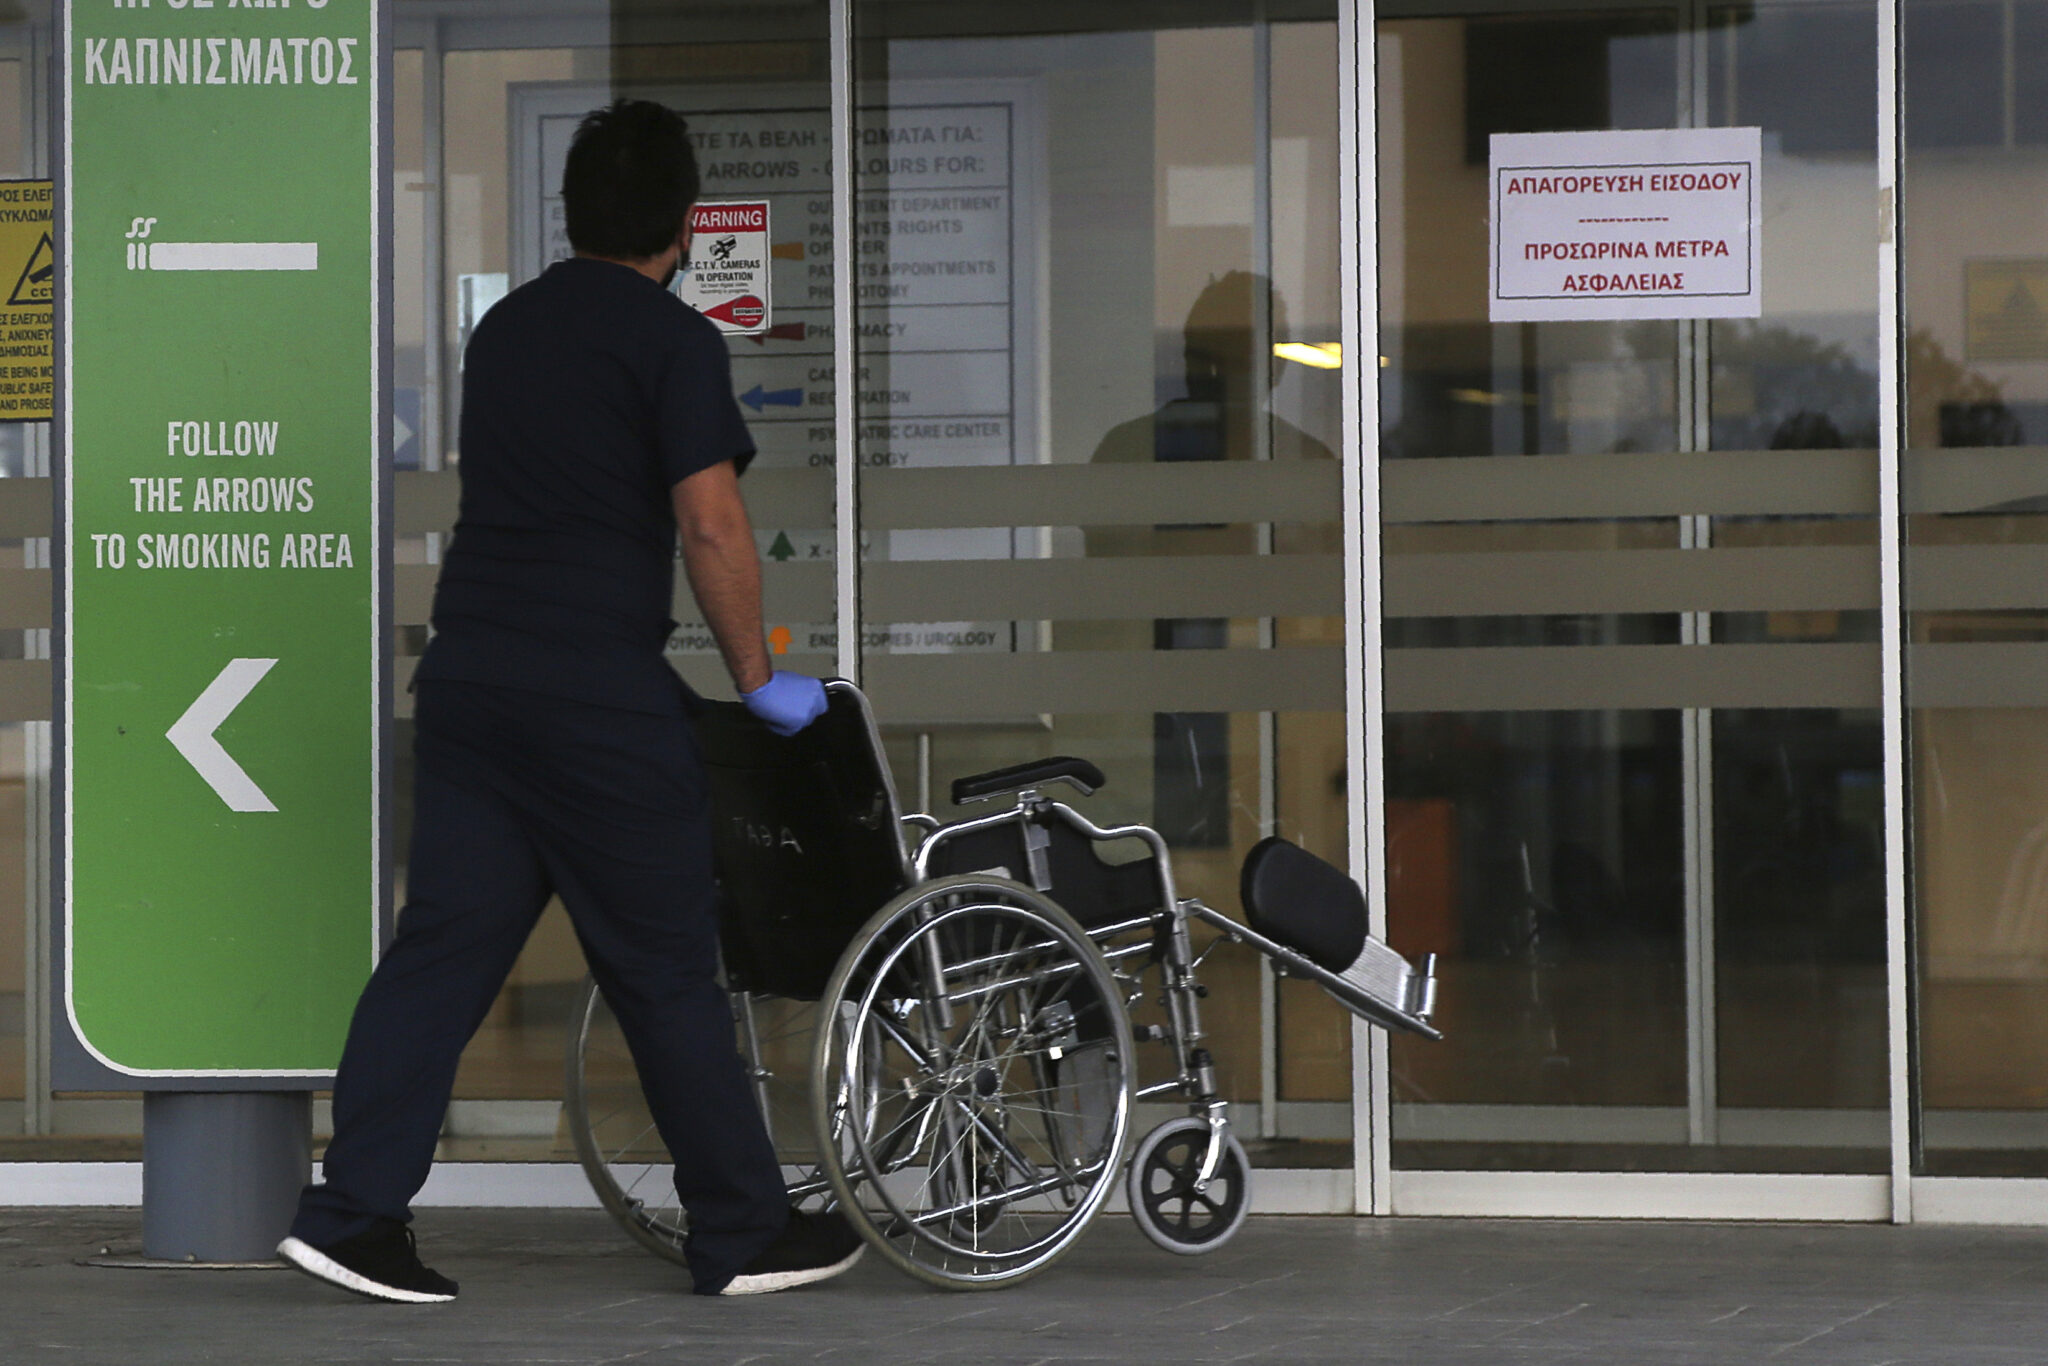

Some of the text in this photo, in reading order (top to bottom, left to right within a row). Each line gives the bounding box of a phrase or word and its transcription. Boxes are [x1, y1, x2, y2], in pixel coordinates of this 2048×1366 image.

[85, 37, 358, 84] ΚΑΠΝΙΣΜΑΤΟΣ
[759, 130, 816, 147] ΒΕΛΗ
[706, 161, 799, 179] ARROWS
[934, 154, 984, 174] FOR:
[1507, 172, 1742, 195] ΑΠΑΓΟΡΕΥΣΗ ΕΙΣΟΔΟΥ
[903, 196, 1000, 212] DEPARTMENT
[898, 219, 964, 234] RIGHTS
[1525, 239, 1730, 261] ΠΡΟΣΩΡΙΝΑ ΜΕΤΡΑ
[720, 259, 761, 270] CAMERAS
[880, 261, 997, 276] APPOINTMENTS
[695, 272, 754, 282] IN OPERATION
[1563, 273, 1685, 292] ΑΣΦΑΛΕΙΑΣ
[11, 366, 38, 378] BEING
[168, 421, 279, 456] FOLLOW
[903, 424, 940, 439] CARE
[944, 423, 1001, 438] CENTER
[129, 477, 314, 513] THE ARROWS
[91, 533, 353, 569] TO SMOKING AREA
[923, 632, 996, 648] UROLOGY
